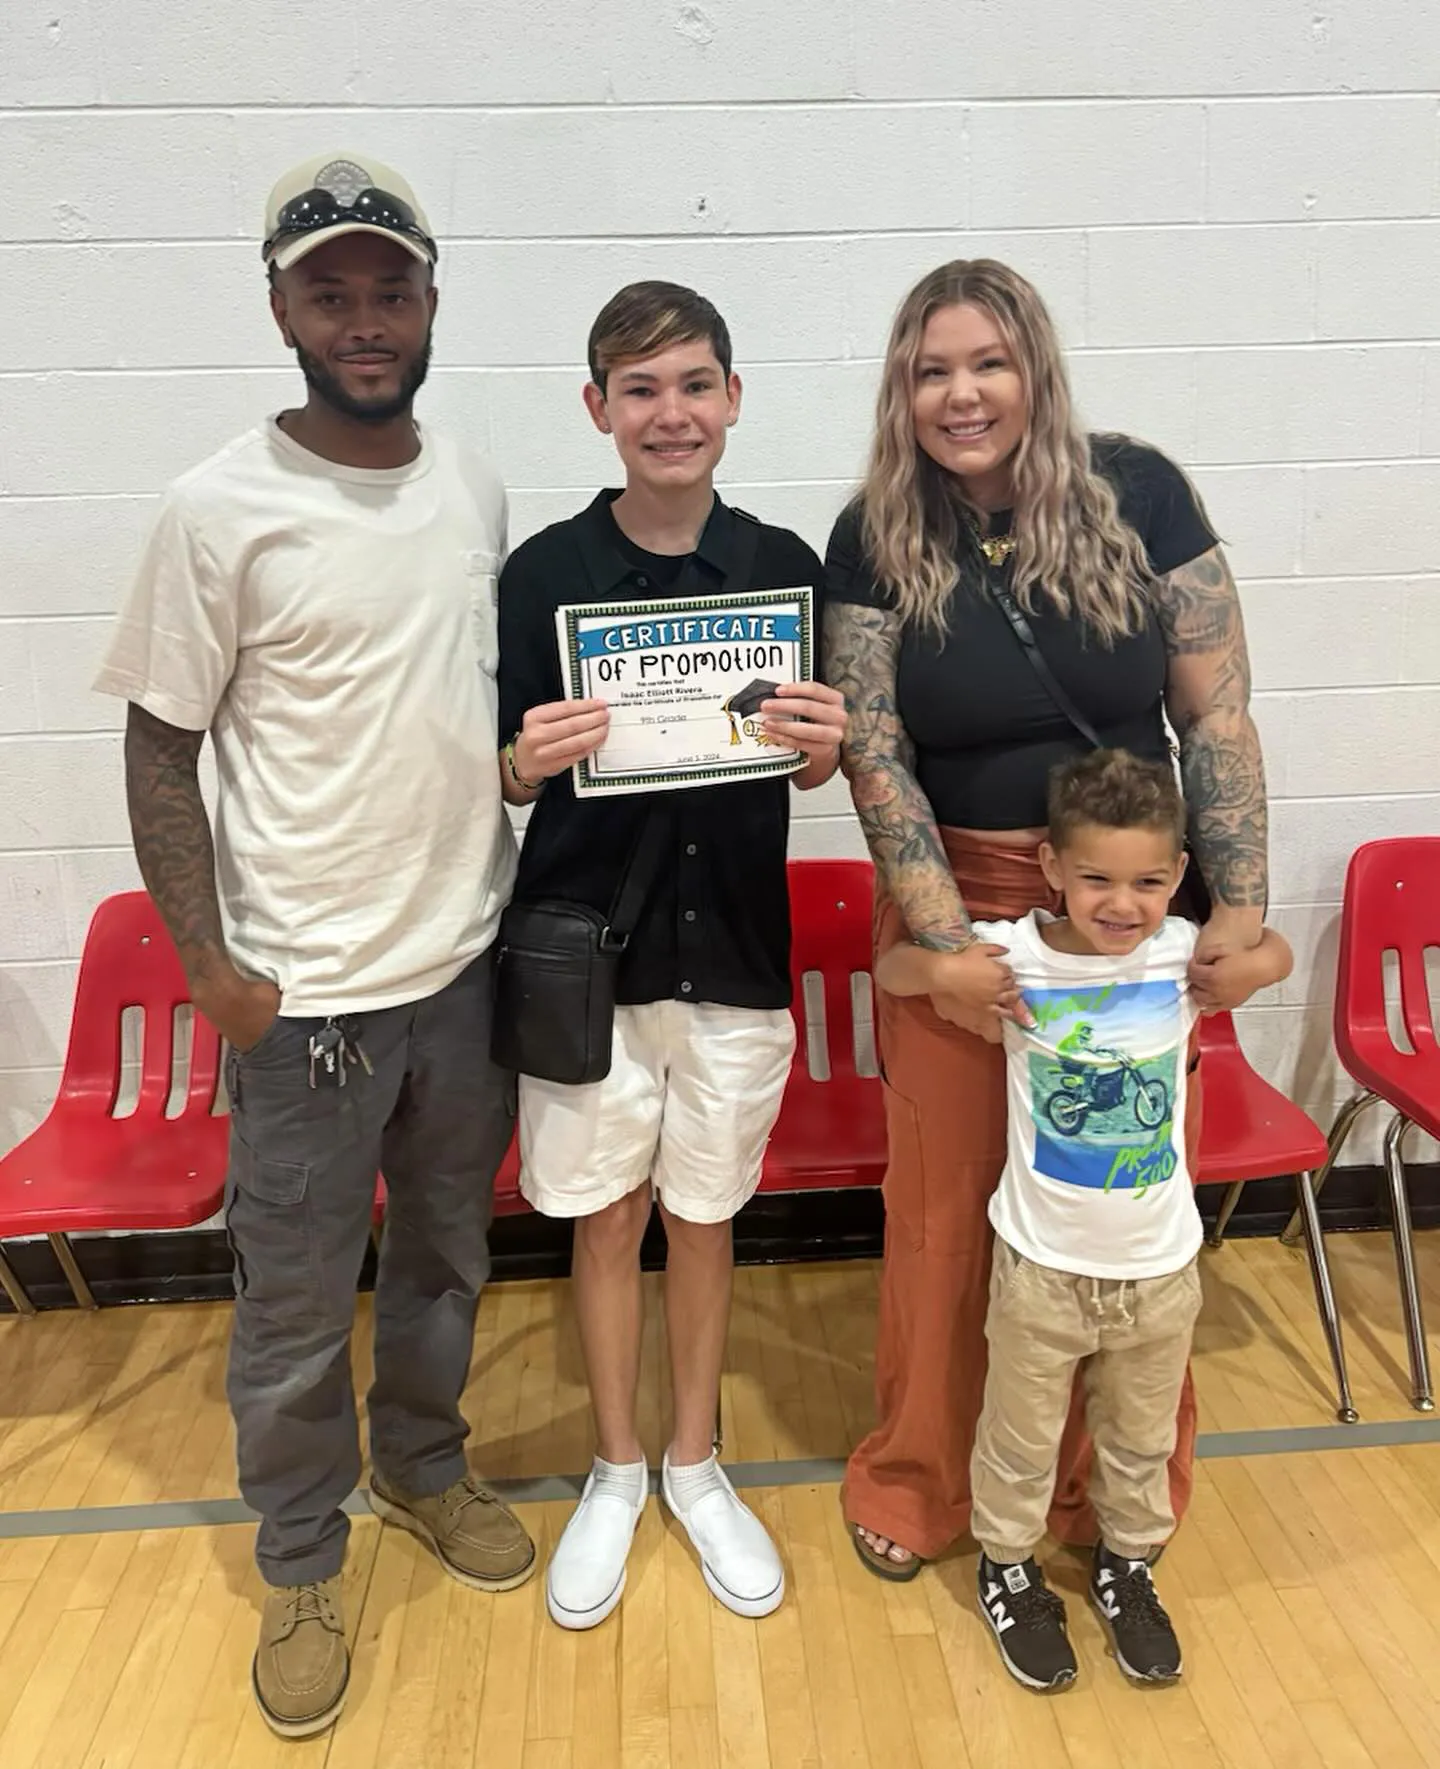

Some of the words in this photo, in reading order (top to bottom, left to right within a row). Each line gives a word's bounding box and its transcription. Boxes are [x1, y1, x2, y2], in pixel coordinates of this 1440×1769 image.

[604, 617, 776, 650] CERTIFICATE
[675, 687, 703, 695] Rivera
[657, 714, 687, 724] Grade
